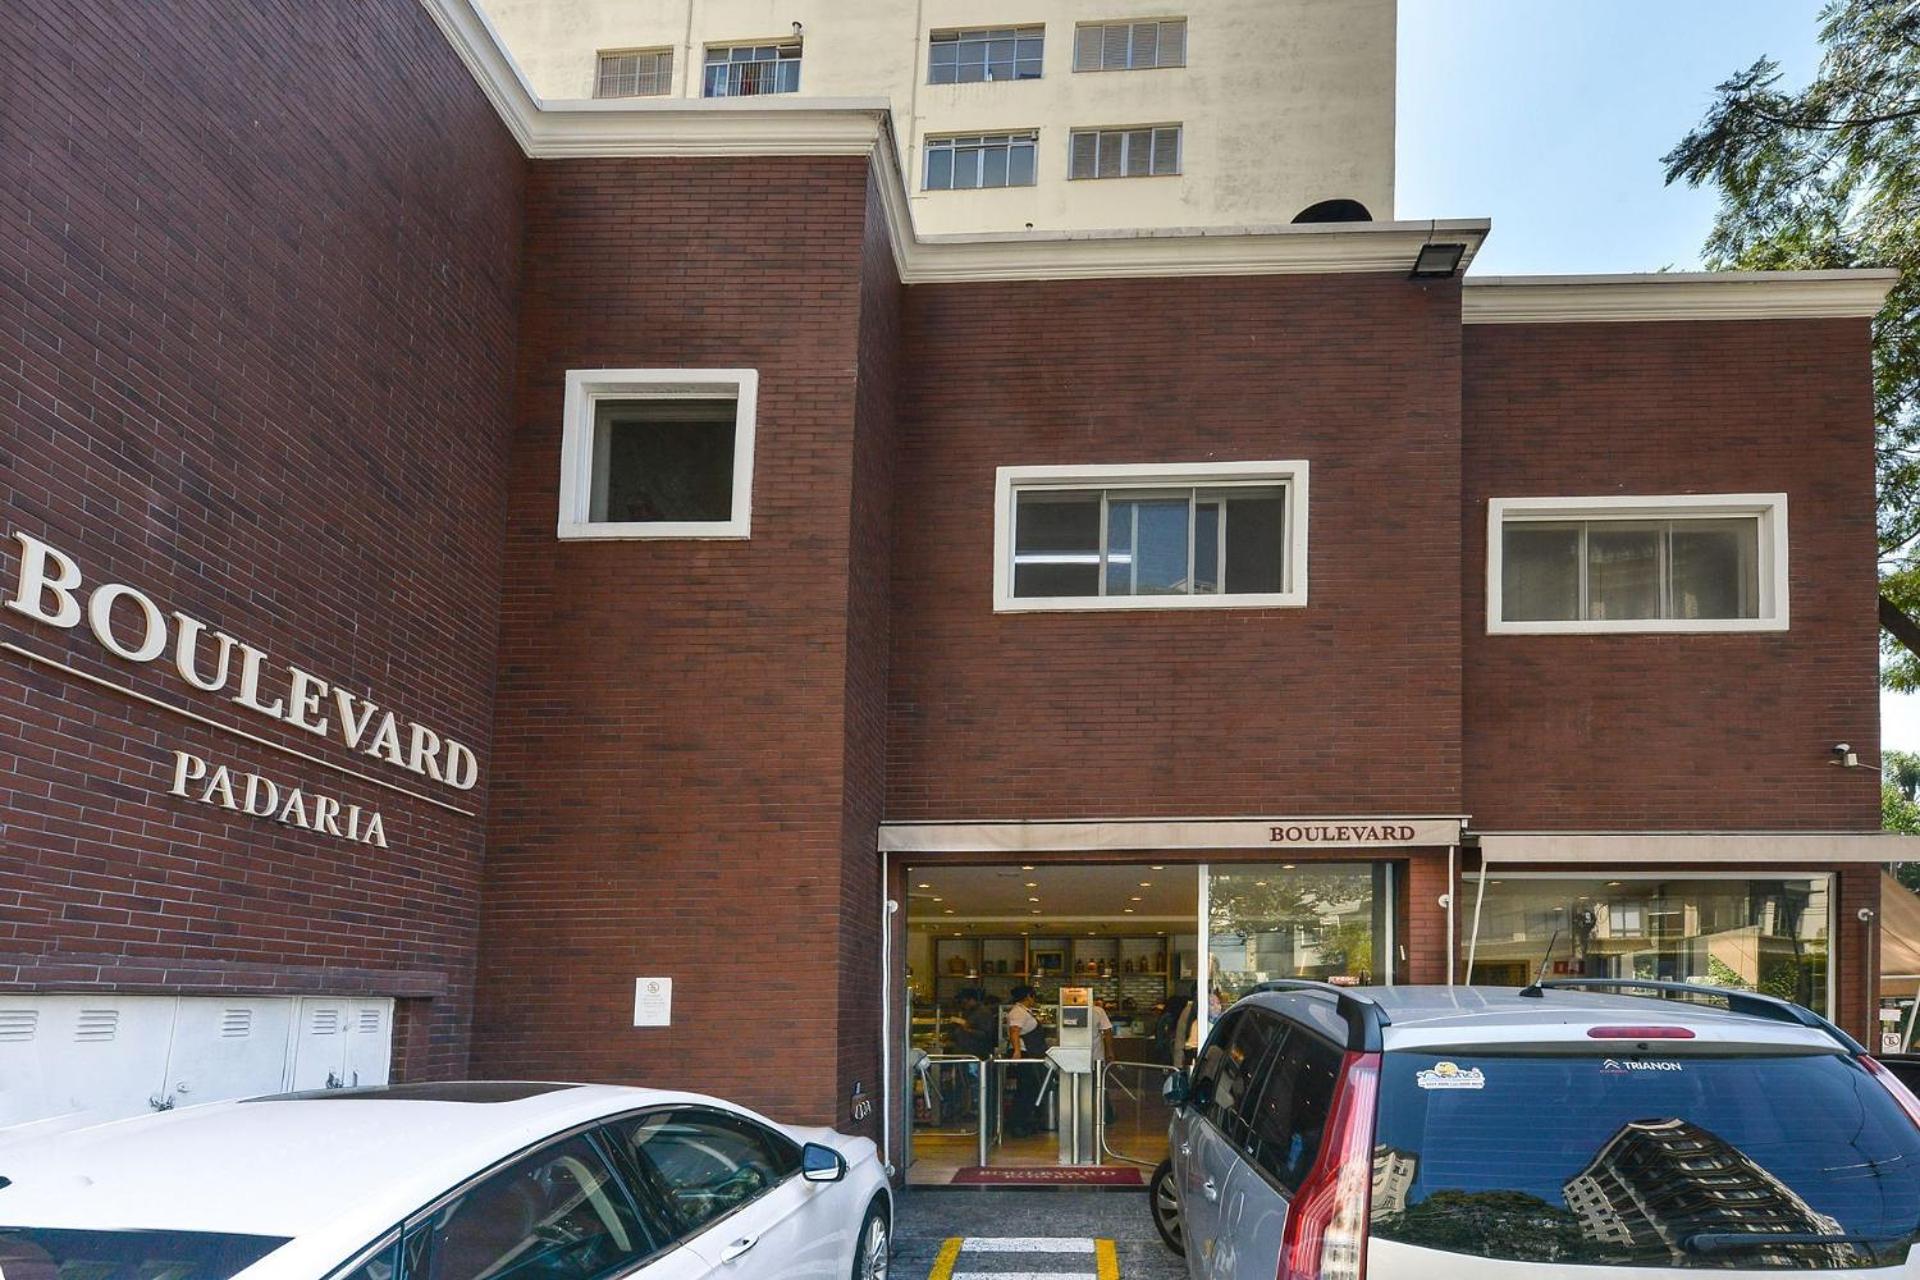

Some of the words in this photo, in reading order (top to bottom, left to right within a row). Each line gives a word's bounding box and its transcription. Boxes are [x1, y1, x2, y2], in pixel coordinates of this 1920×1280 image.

[6, 531, 478, 791] BOULEVARD
[167, 750, 390, 848] PADARIA
[1269, 825, 1415, 842] BOULEVARD
[1622, 1061, 1683, 1071] TRIANON
